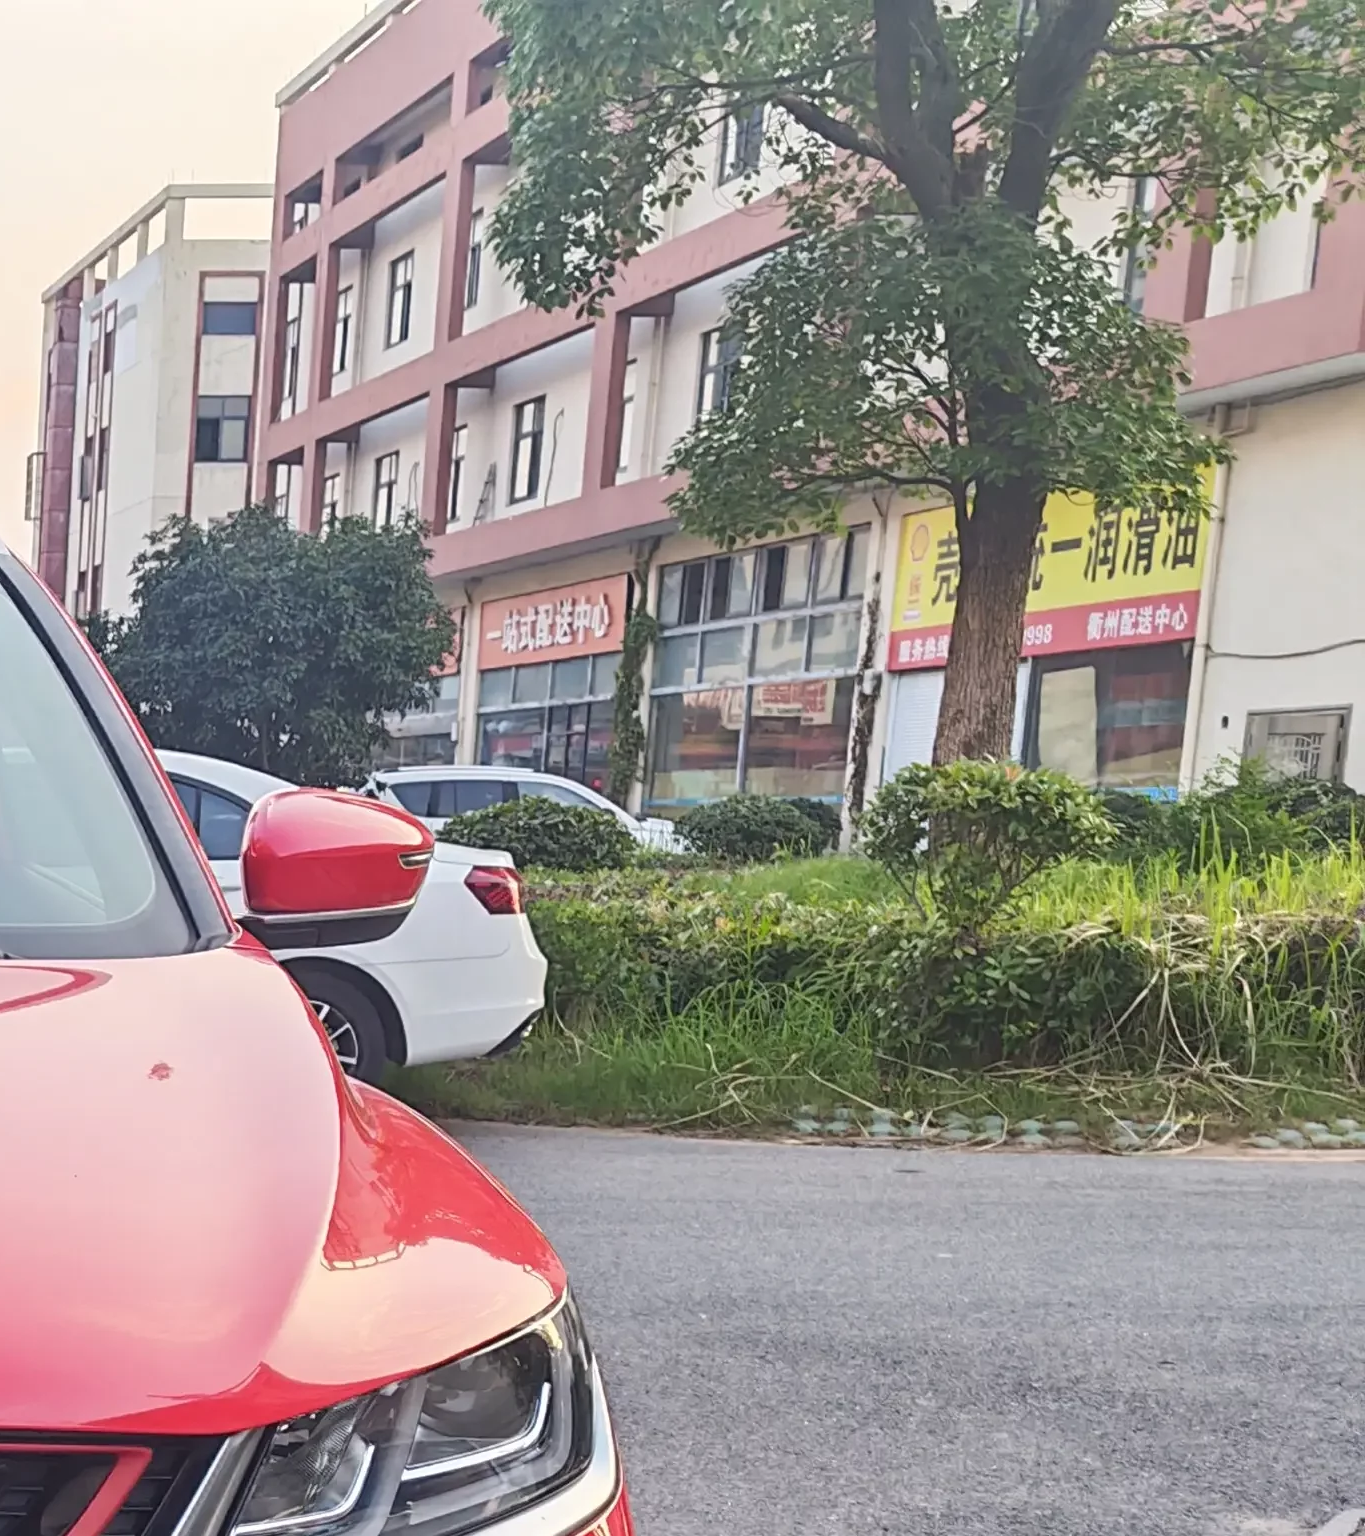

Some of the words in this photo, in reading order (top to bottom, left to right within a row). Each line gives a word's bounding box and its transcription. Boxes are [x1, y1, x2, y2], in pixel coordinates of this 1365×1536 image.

[485, 592, 610, 654] 一站式配送中心
